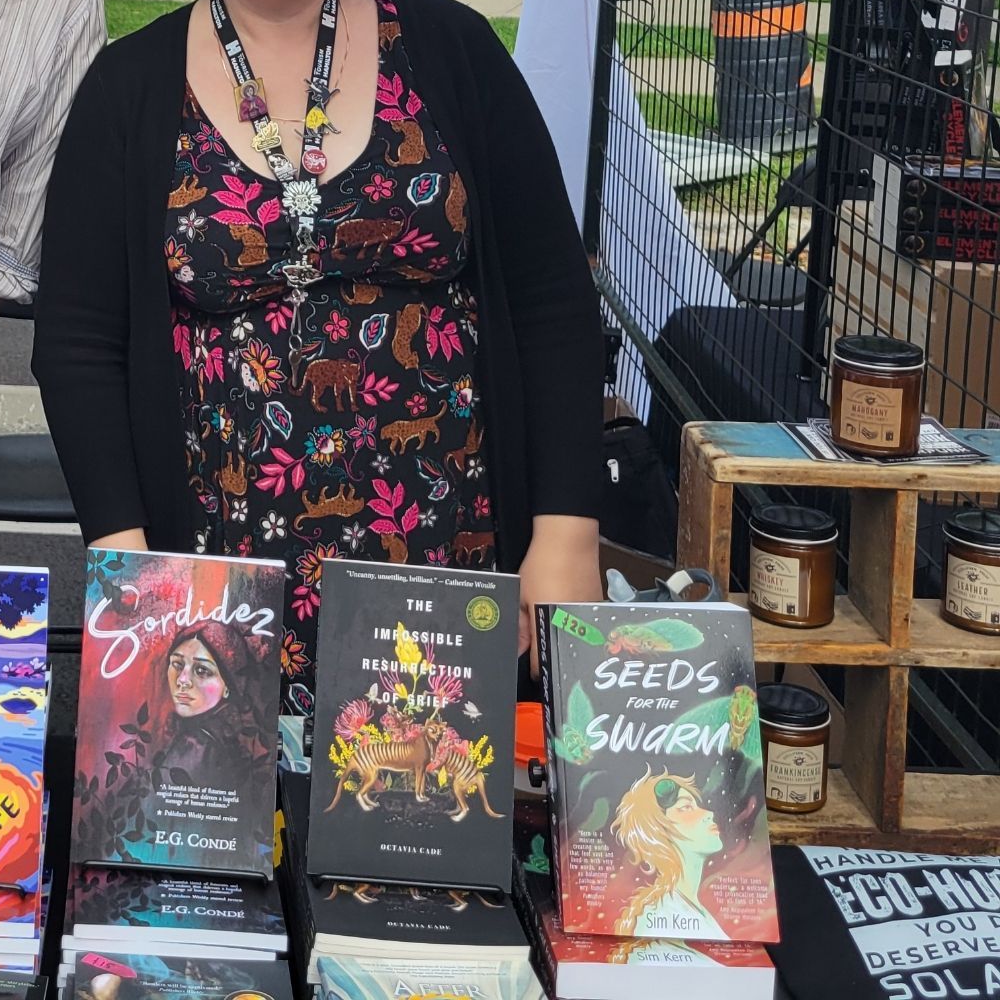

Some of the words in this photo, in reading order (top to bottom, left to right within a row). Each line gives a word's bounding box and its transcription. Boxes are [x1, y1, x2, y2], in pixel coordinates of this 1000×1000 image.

[238, 54, 251, 80] TOURISM
[315, 49, 324, 75] TOURISM
[323, 46, 332, 77] HAMILTON
[851, 404, 888, 417] MAHOGANY
[378, 574, 408, 583] unsettling,
[445, 579, 473, 587] Catherine
[757, 571, 783, 586] WHISKEY
[957, 580, 988, 595] LEATHER
[407, 599, 432, 612] THE
[88, 583, 275, 679] Sordidez
[561, 613, 587, 637] $20
[374, 627, 463, 646] IMPOSSIBLE
[362, 658, 472, 679] RESURRECTION
[594, 657, 719, 693] SEEDS
[383, 692, 399, 703] OF
[408, 696, 450, 708] GRIEF
[626, 697, 654, 709] FOR
[656, 697, 680, 709] THE
[155, 831, 184, 846] E.G.
[381, 844, 417, 854] OCTAVIA
[420, 847, 442, 856] CADE
[813, 853, 933, 871] HANDLE
[161, 905, 190, 914] E.G.
[387, 921, 425, 929] OCTAVIA
[646, 912, 667, 929] Sim
[672, 914, 700, 931] Kern
[915, 915, 977, 937] YOU
[637, 951, 660, 962] Sim
[665, 952, 693, 963] Kern
